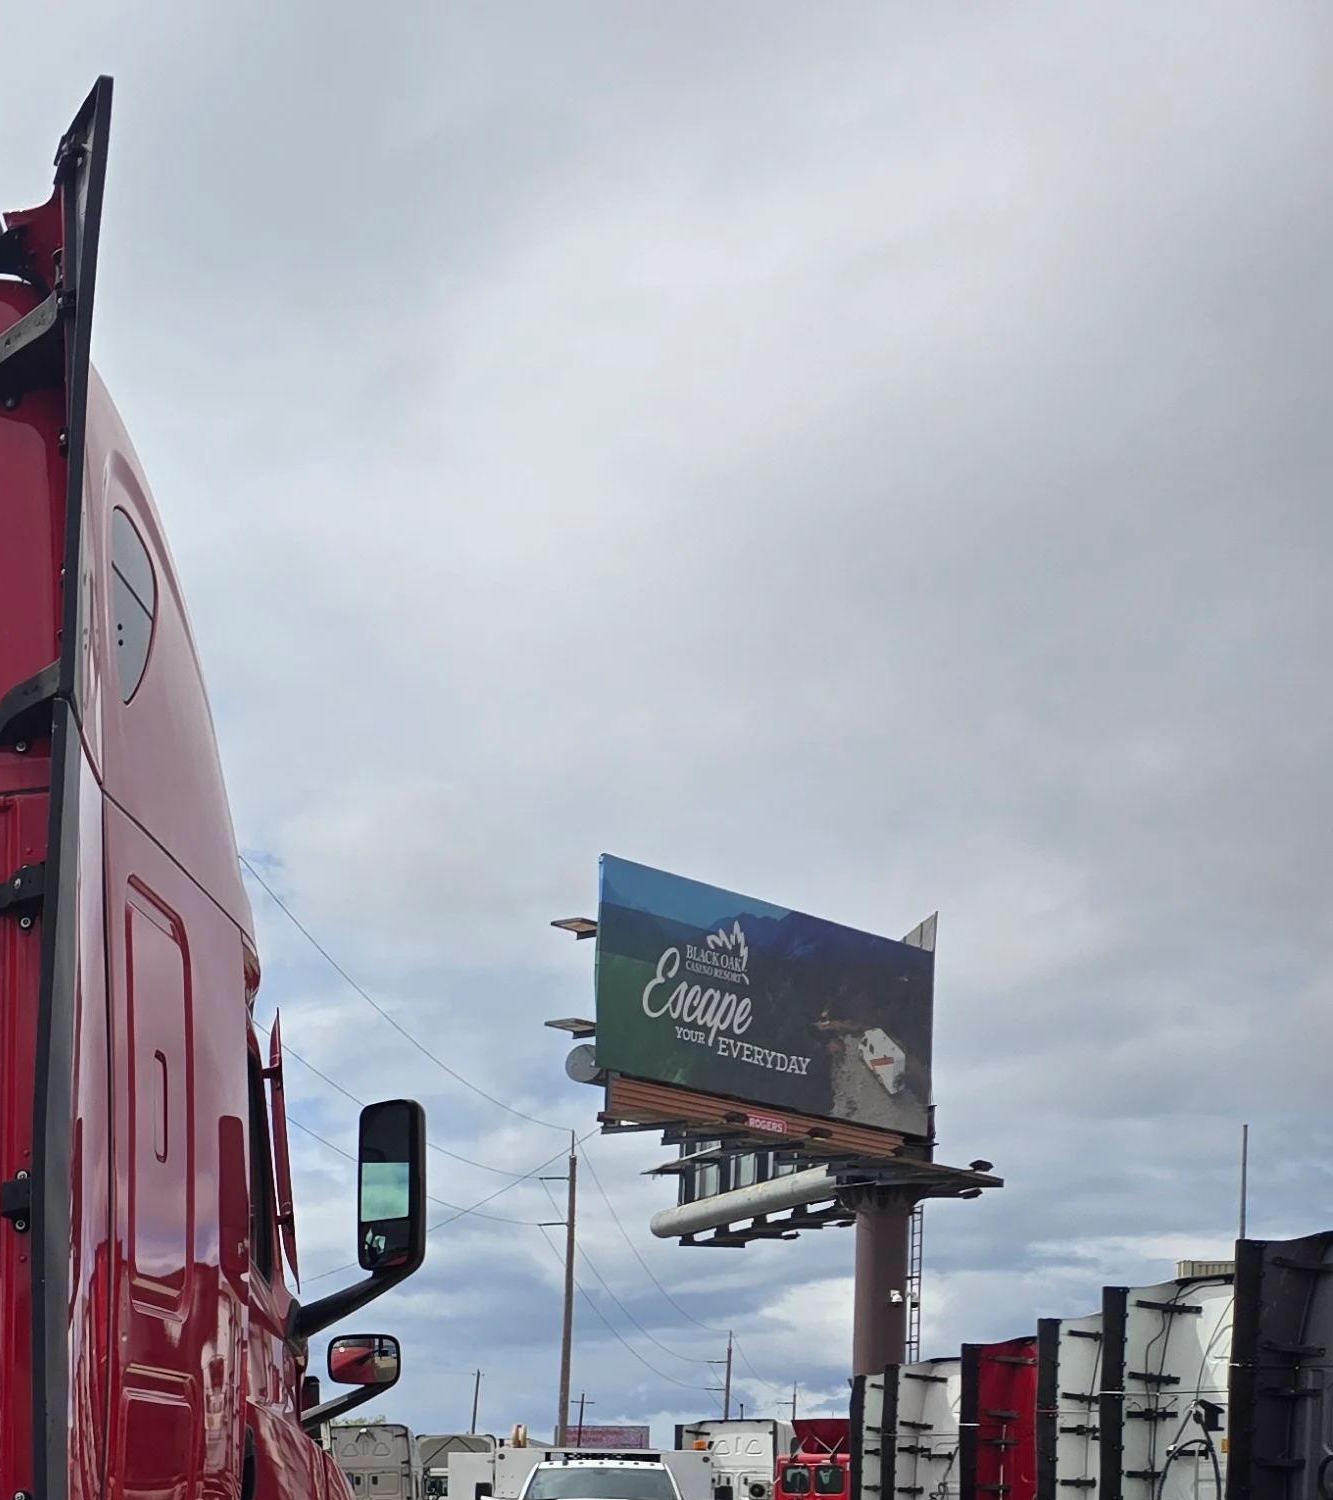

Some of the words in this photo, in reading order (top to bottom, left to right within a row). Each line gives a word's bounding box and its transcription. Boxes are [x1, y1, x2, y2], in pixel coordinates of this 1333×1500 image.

[686, 944, 720, 966] BLACK
[720, 953, 742, 971] OAK
[685, 960, 712, 977] CASINO
[713, 967, 742, 984] RESORT
[642, 947, 753, 1047] Escape
[675, 1025, 706, 1044] YOUR
[717, 1036, 811, 1075] EVERYDAY
[748, 1117, 784, 1133] ROGERS
